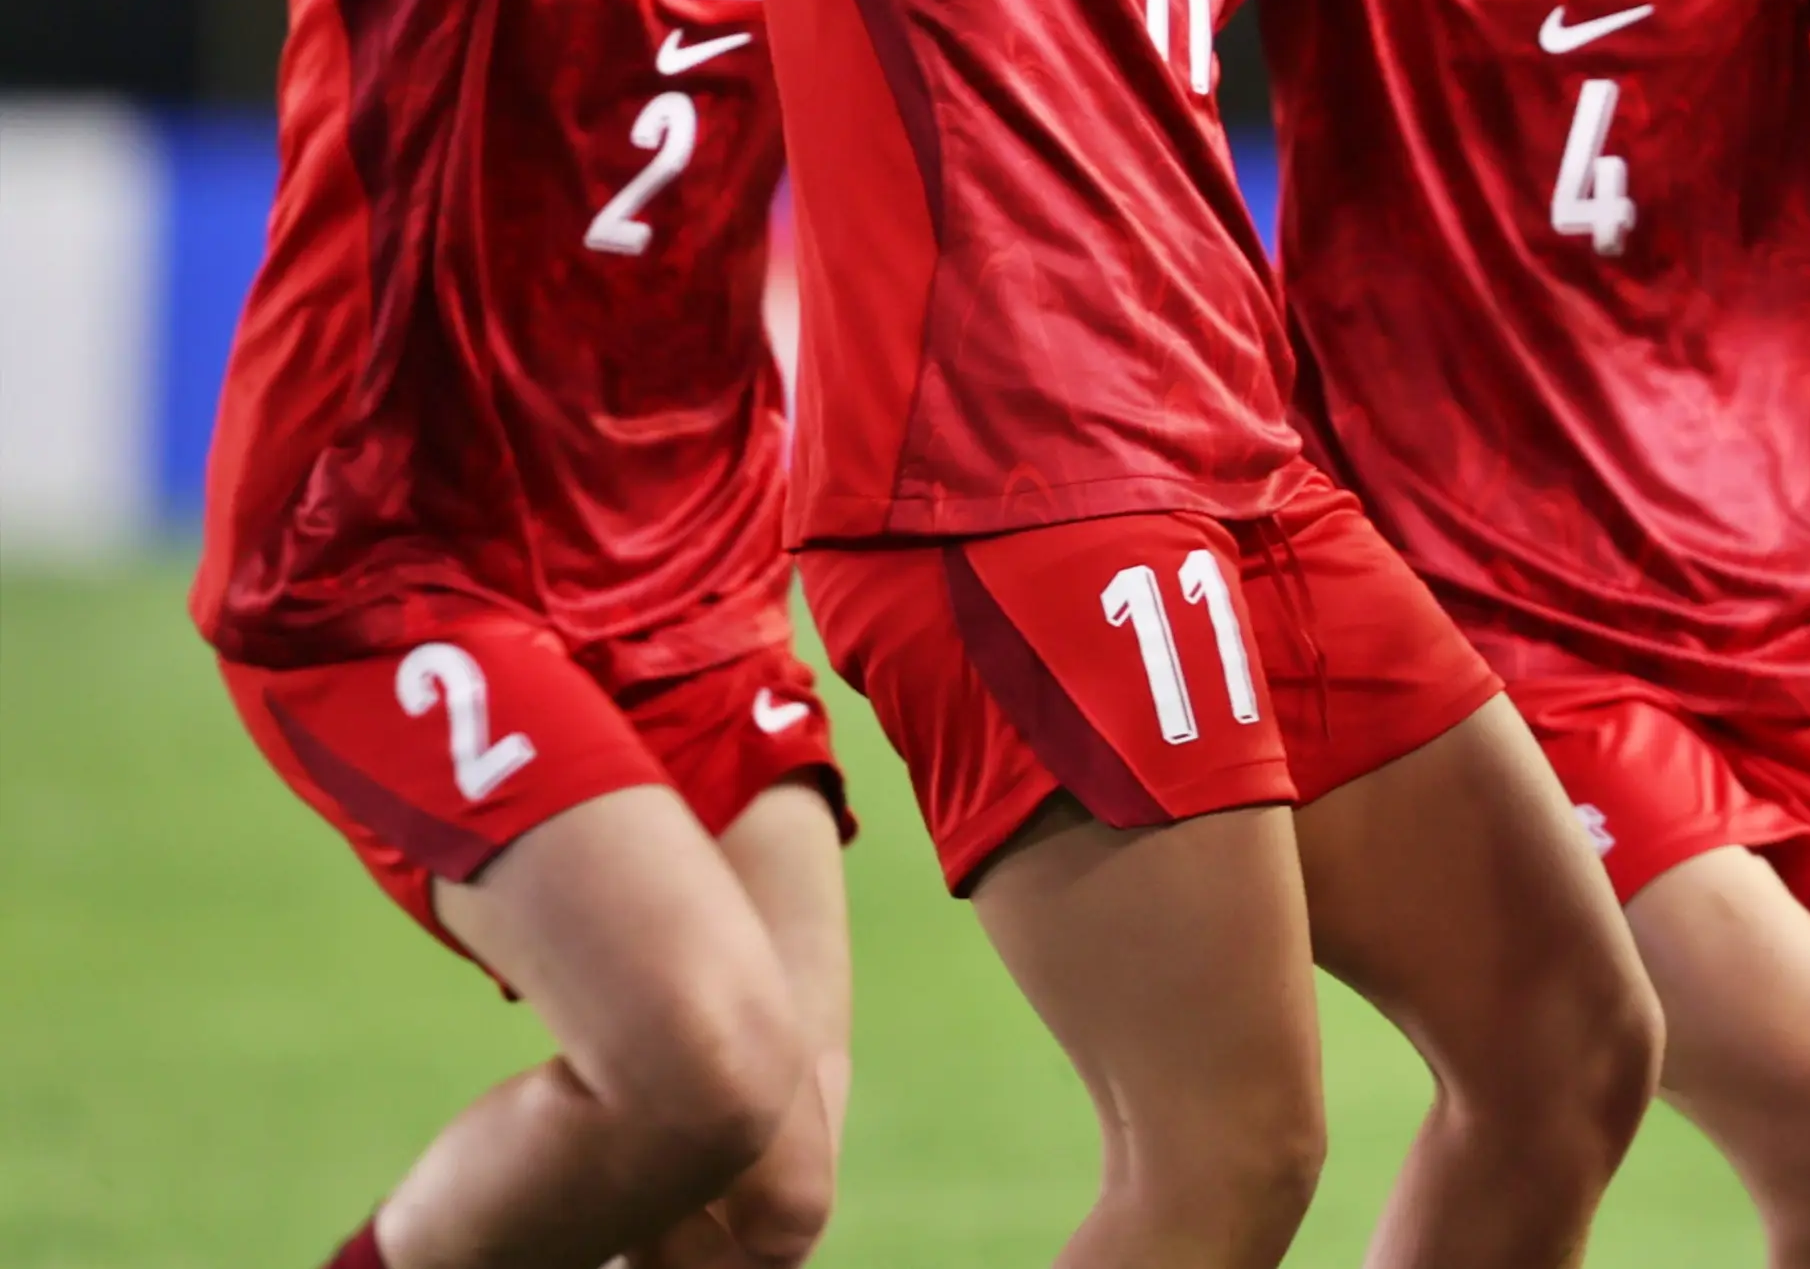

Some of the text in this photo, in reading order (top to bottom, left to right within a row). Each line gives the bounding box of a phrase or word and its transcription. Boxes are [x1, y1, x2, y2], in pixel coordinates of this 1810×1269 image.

[584, 91, 697, 255] 2
[1551, 78, 1635, 255] 4
[396, 642, 537, 801] 2
[1100, 549, 1259, 746] 11
